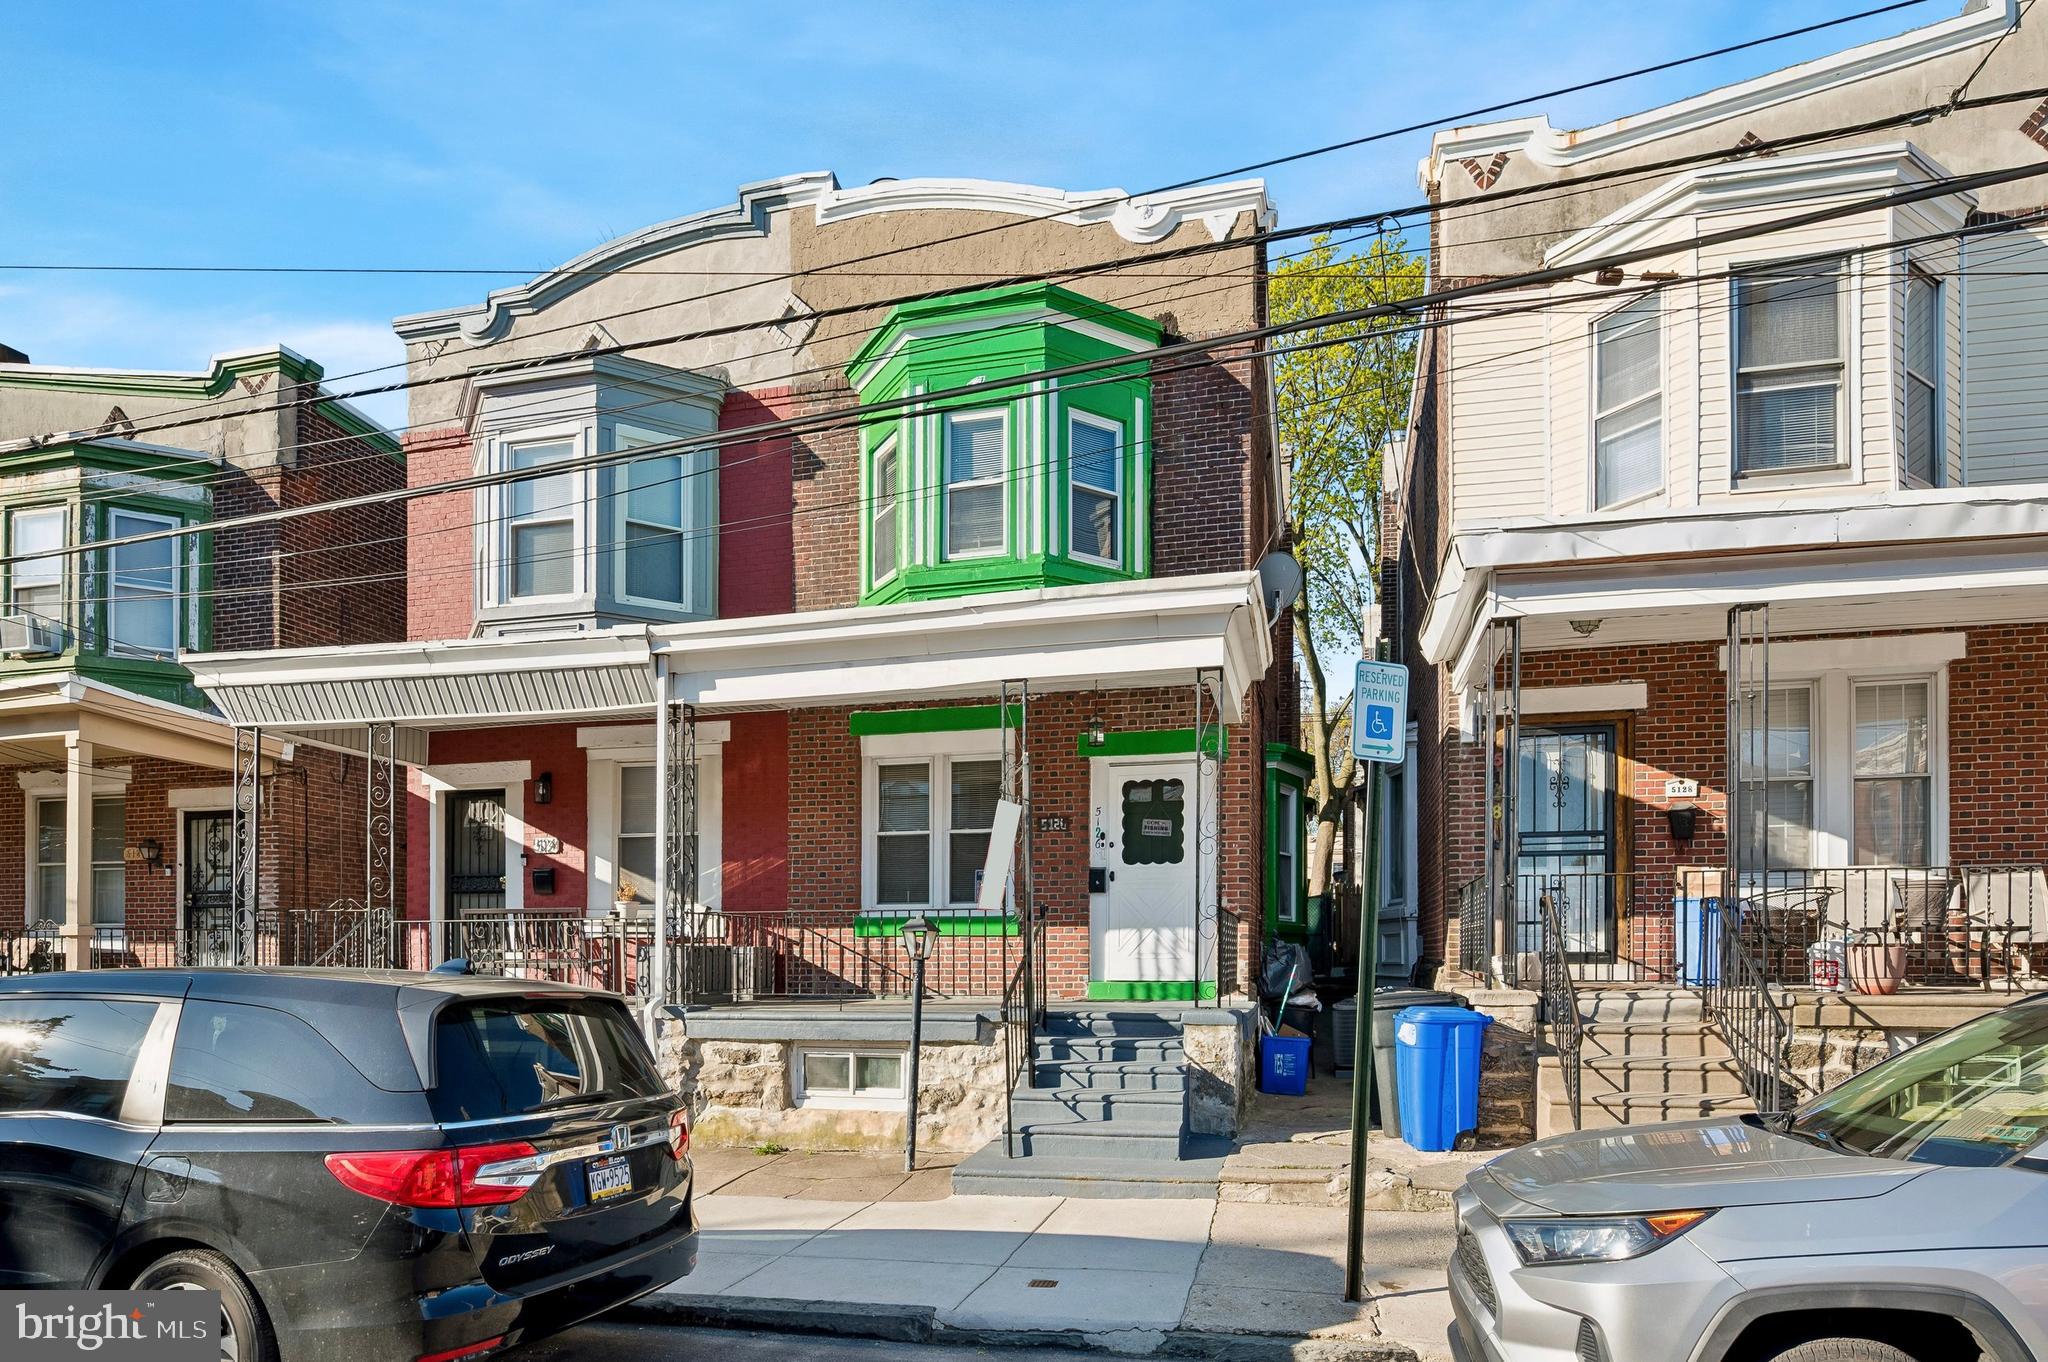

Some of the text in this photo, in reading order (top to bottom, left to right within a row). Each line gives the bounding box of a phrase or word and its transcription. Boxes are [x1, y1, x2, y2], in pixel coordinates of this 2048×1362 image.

[1359, 670, 1404, 687] RESERVED
[1361, 687, 1400, 703] PARKING
[499, 1244, 555, 1266] ODYSSEY
